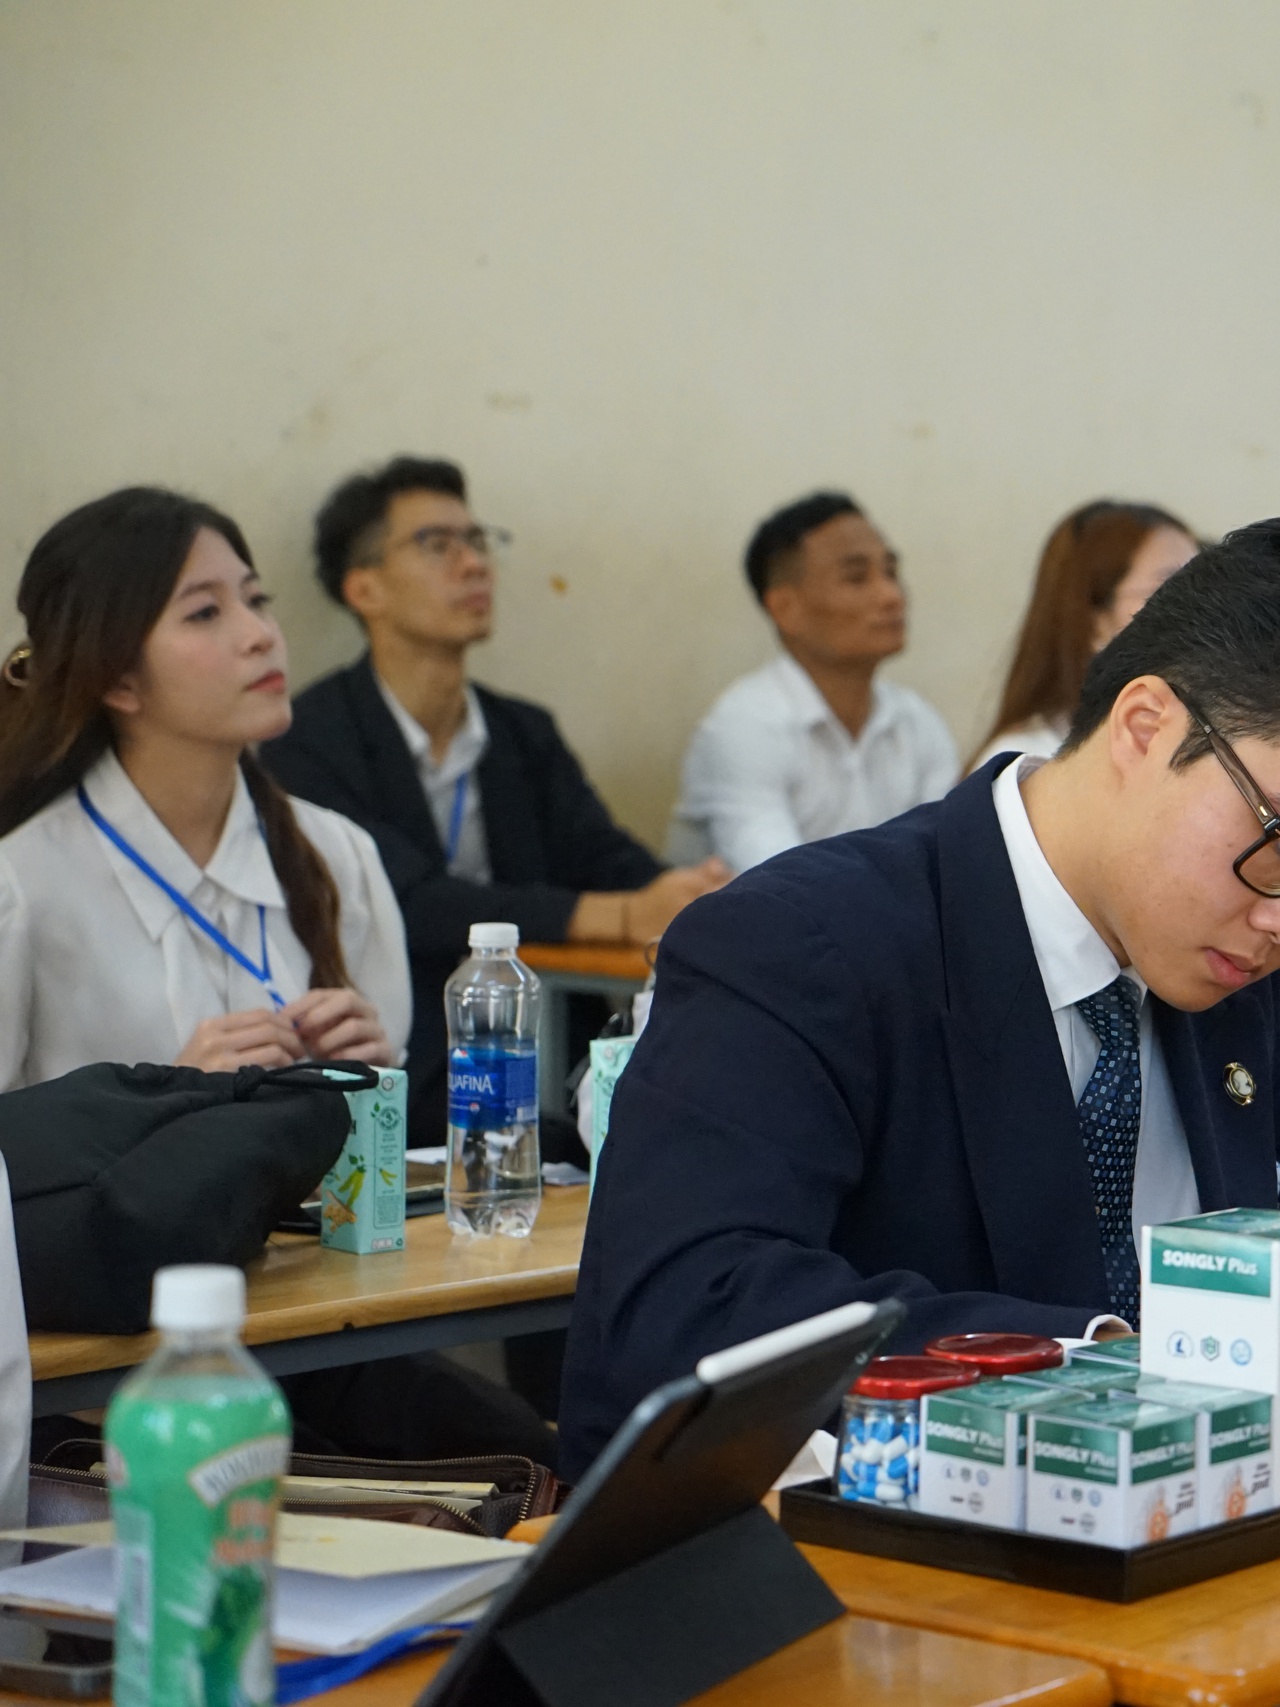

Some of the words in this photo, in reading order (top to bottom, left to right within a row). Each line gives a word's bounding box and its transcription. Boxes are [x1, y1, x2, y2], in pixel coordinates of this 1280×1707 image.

[1162, 1249, 1227, 1272] SONGLY
[1227, 1257, 1258, 1277] Plus
[926, 1421, 978, 1444] SONGLY
[1034, 1440, 1090, 1463] SONGLY
